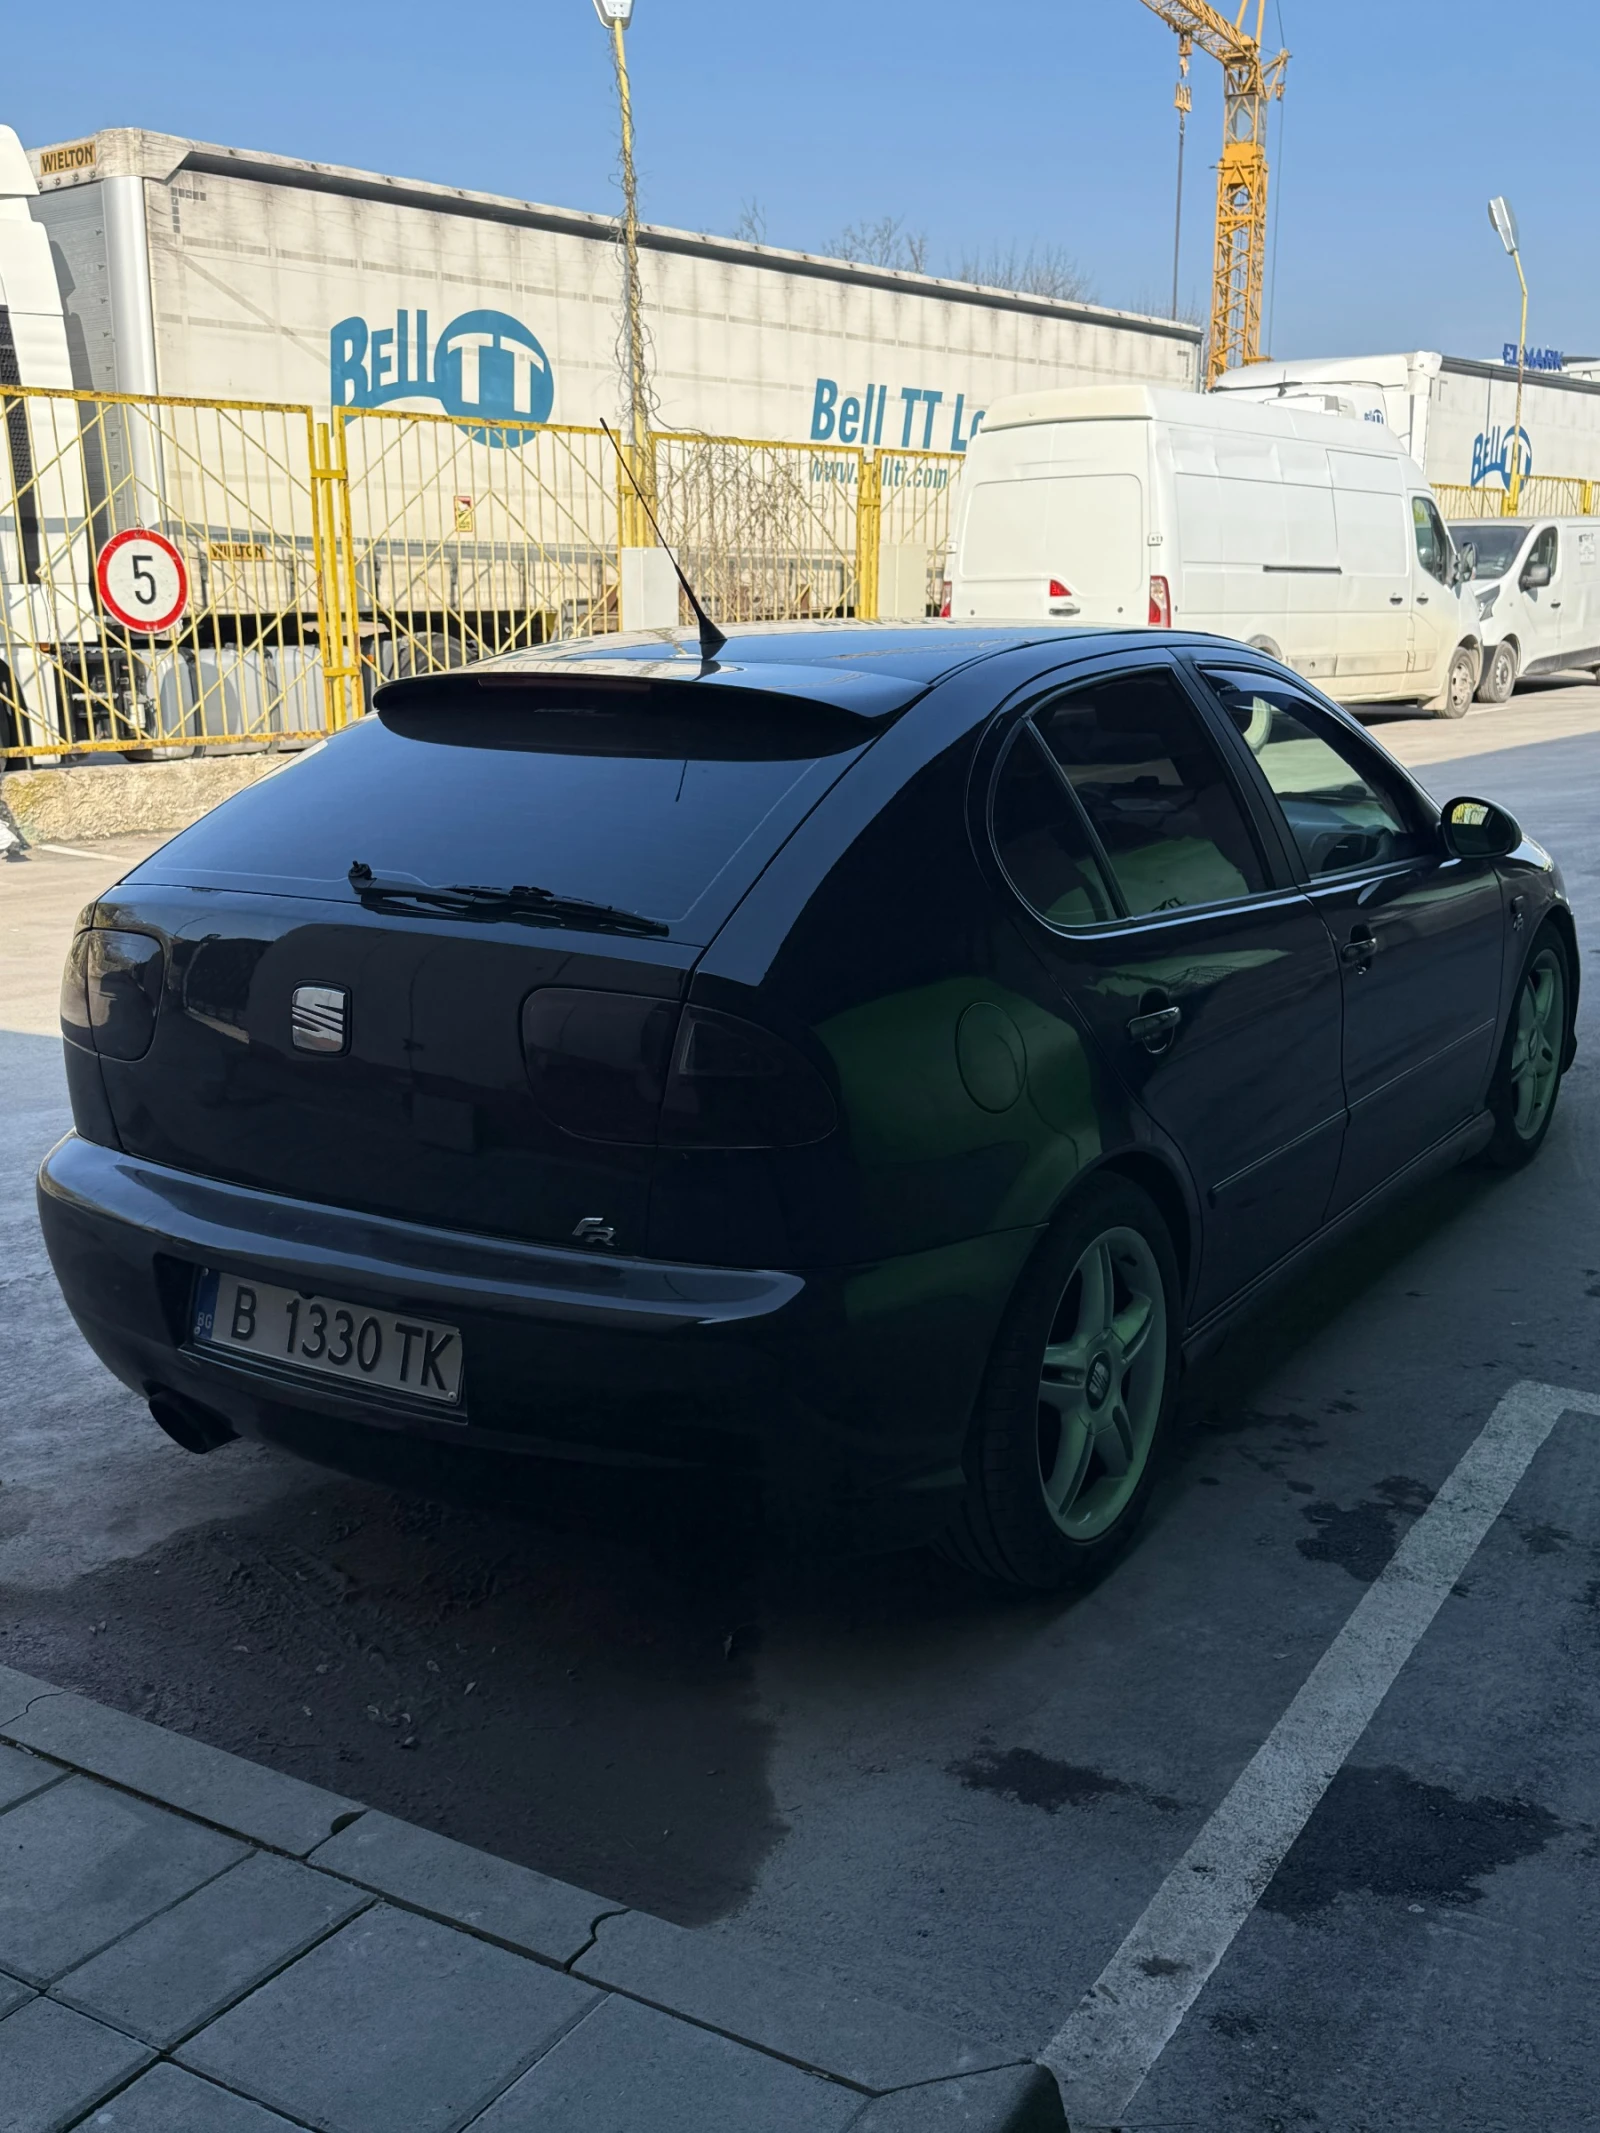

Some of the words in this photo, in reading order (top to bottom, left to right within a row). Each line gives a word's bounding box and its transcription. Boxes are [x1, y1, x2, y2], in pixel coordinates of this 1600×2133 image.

[42, 145, 93, 172] WIELTON
[810, 378, 887, 445] Bell
[901, 387, 943, 449] TT
[811, 457, 947, 488] www.lltt.com
[132, 555, 156, 605] 5
[572, 1217, 616, 1246] FR
[197, 1311, 213, 1329] BG
[230, 1285, 257, 1341] B
[286, 1298, 382, 1373] 1330
[395, 1322, 454, 1391] TK
